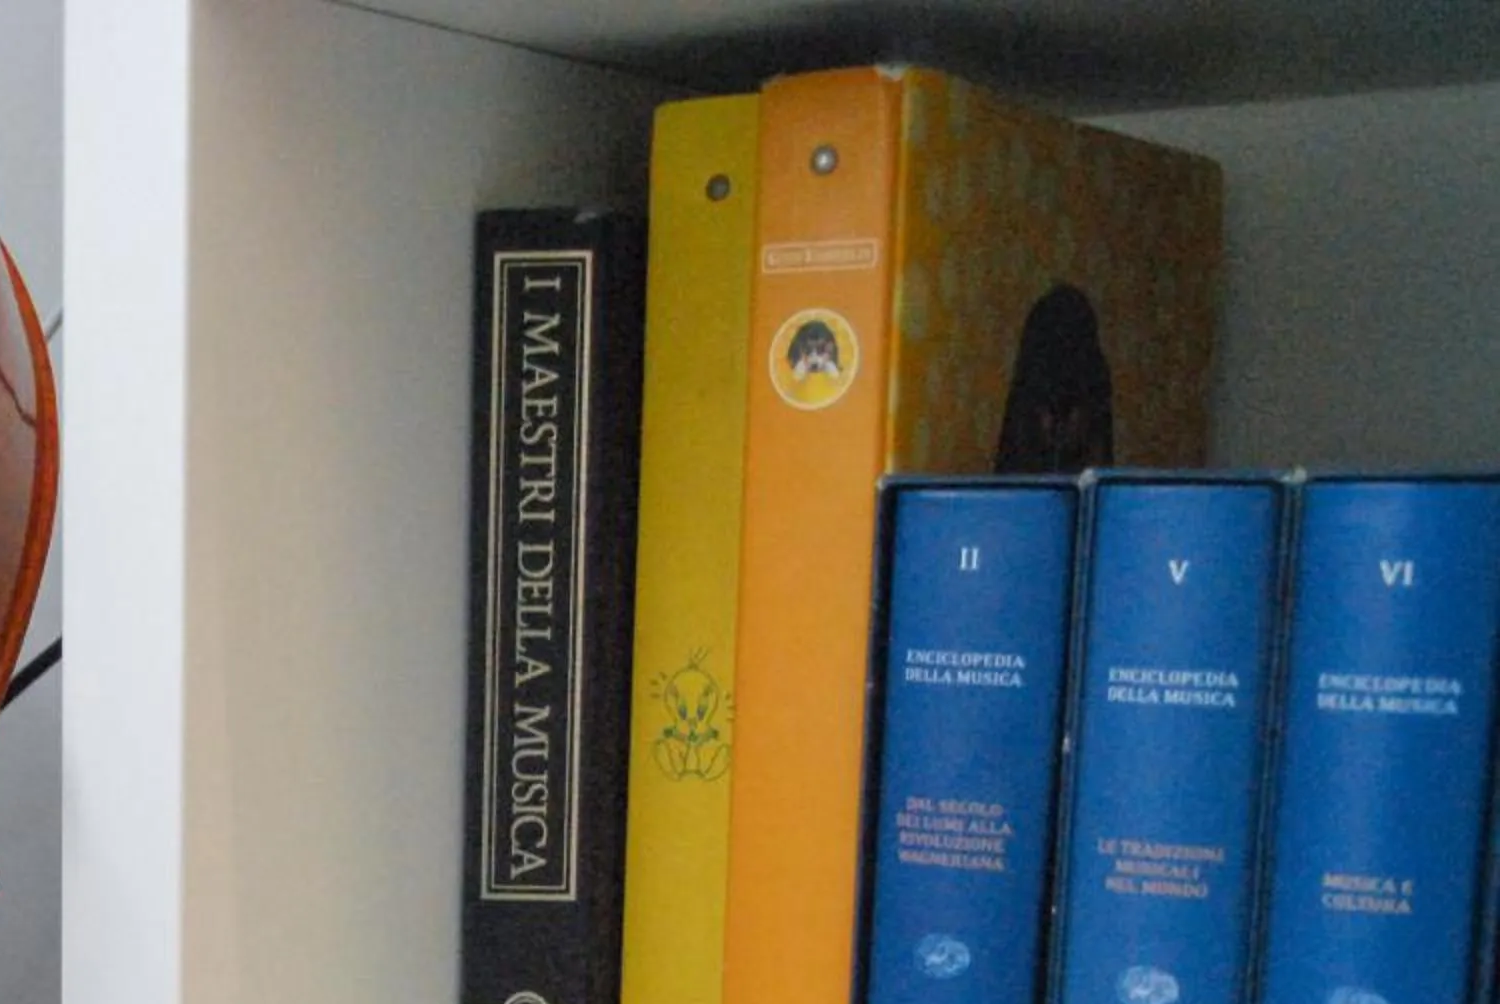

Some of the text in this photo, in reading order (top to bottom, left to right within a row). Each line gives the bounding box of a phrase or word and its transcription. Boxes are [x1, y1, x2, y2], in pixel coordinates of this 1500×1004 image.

[959, 547, 980, 570] II
[510, 275, 562, 880] I MAESTRI DELLA MUSICA
[1168, 559, 1189, 585] V
[1379, 560, 1415, 587] VI
[906, 648, 1026, 669] ENCICLOPEDIA
[904, 667, 1023, 688] DELLA MUSICA
[1108, 667, 1240, 688] ENCICLOPEDIA
[1318, 673, 1462, 696] ENCICLOPEDIA
[1107, 685, 1236, 708] DELLA MUSICA
[1317, 692, 1458, 716] DELLA MUSICA
[968, 820, 1013, 835] ALLA
